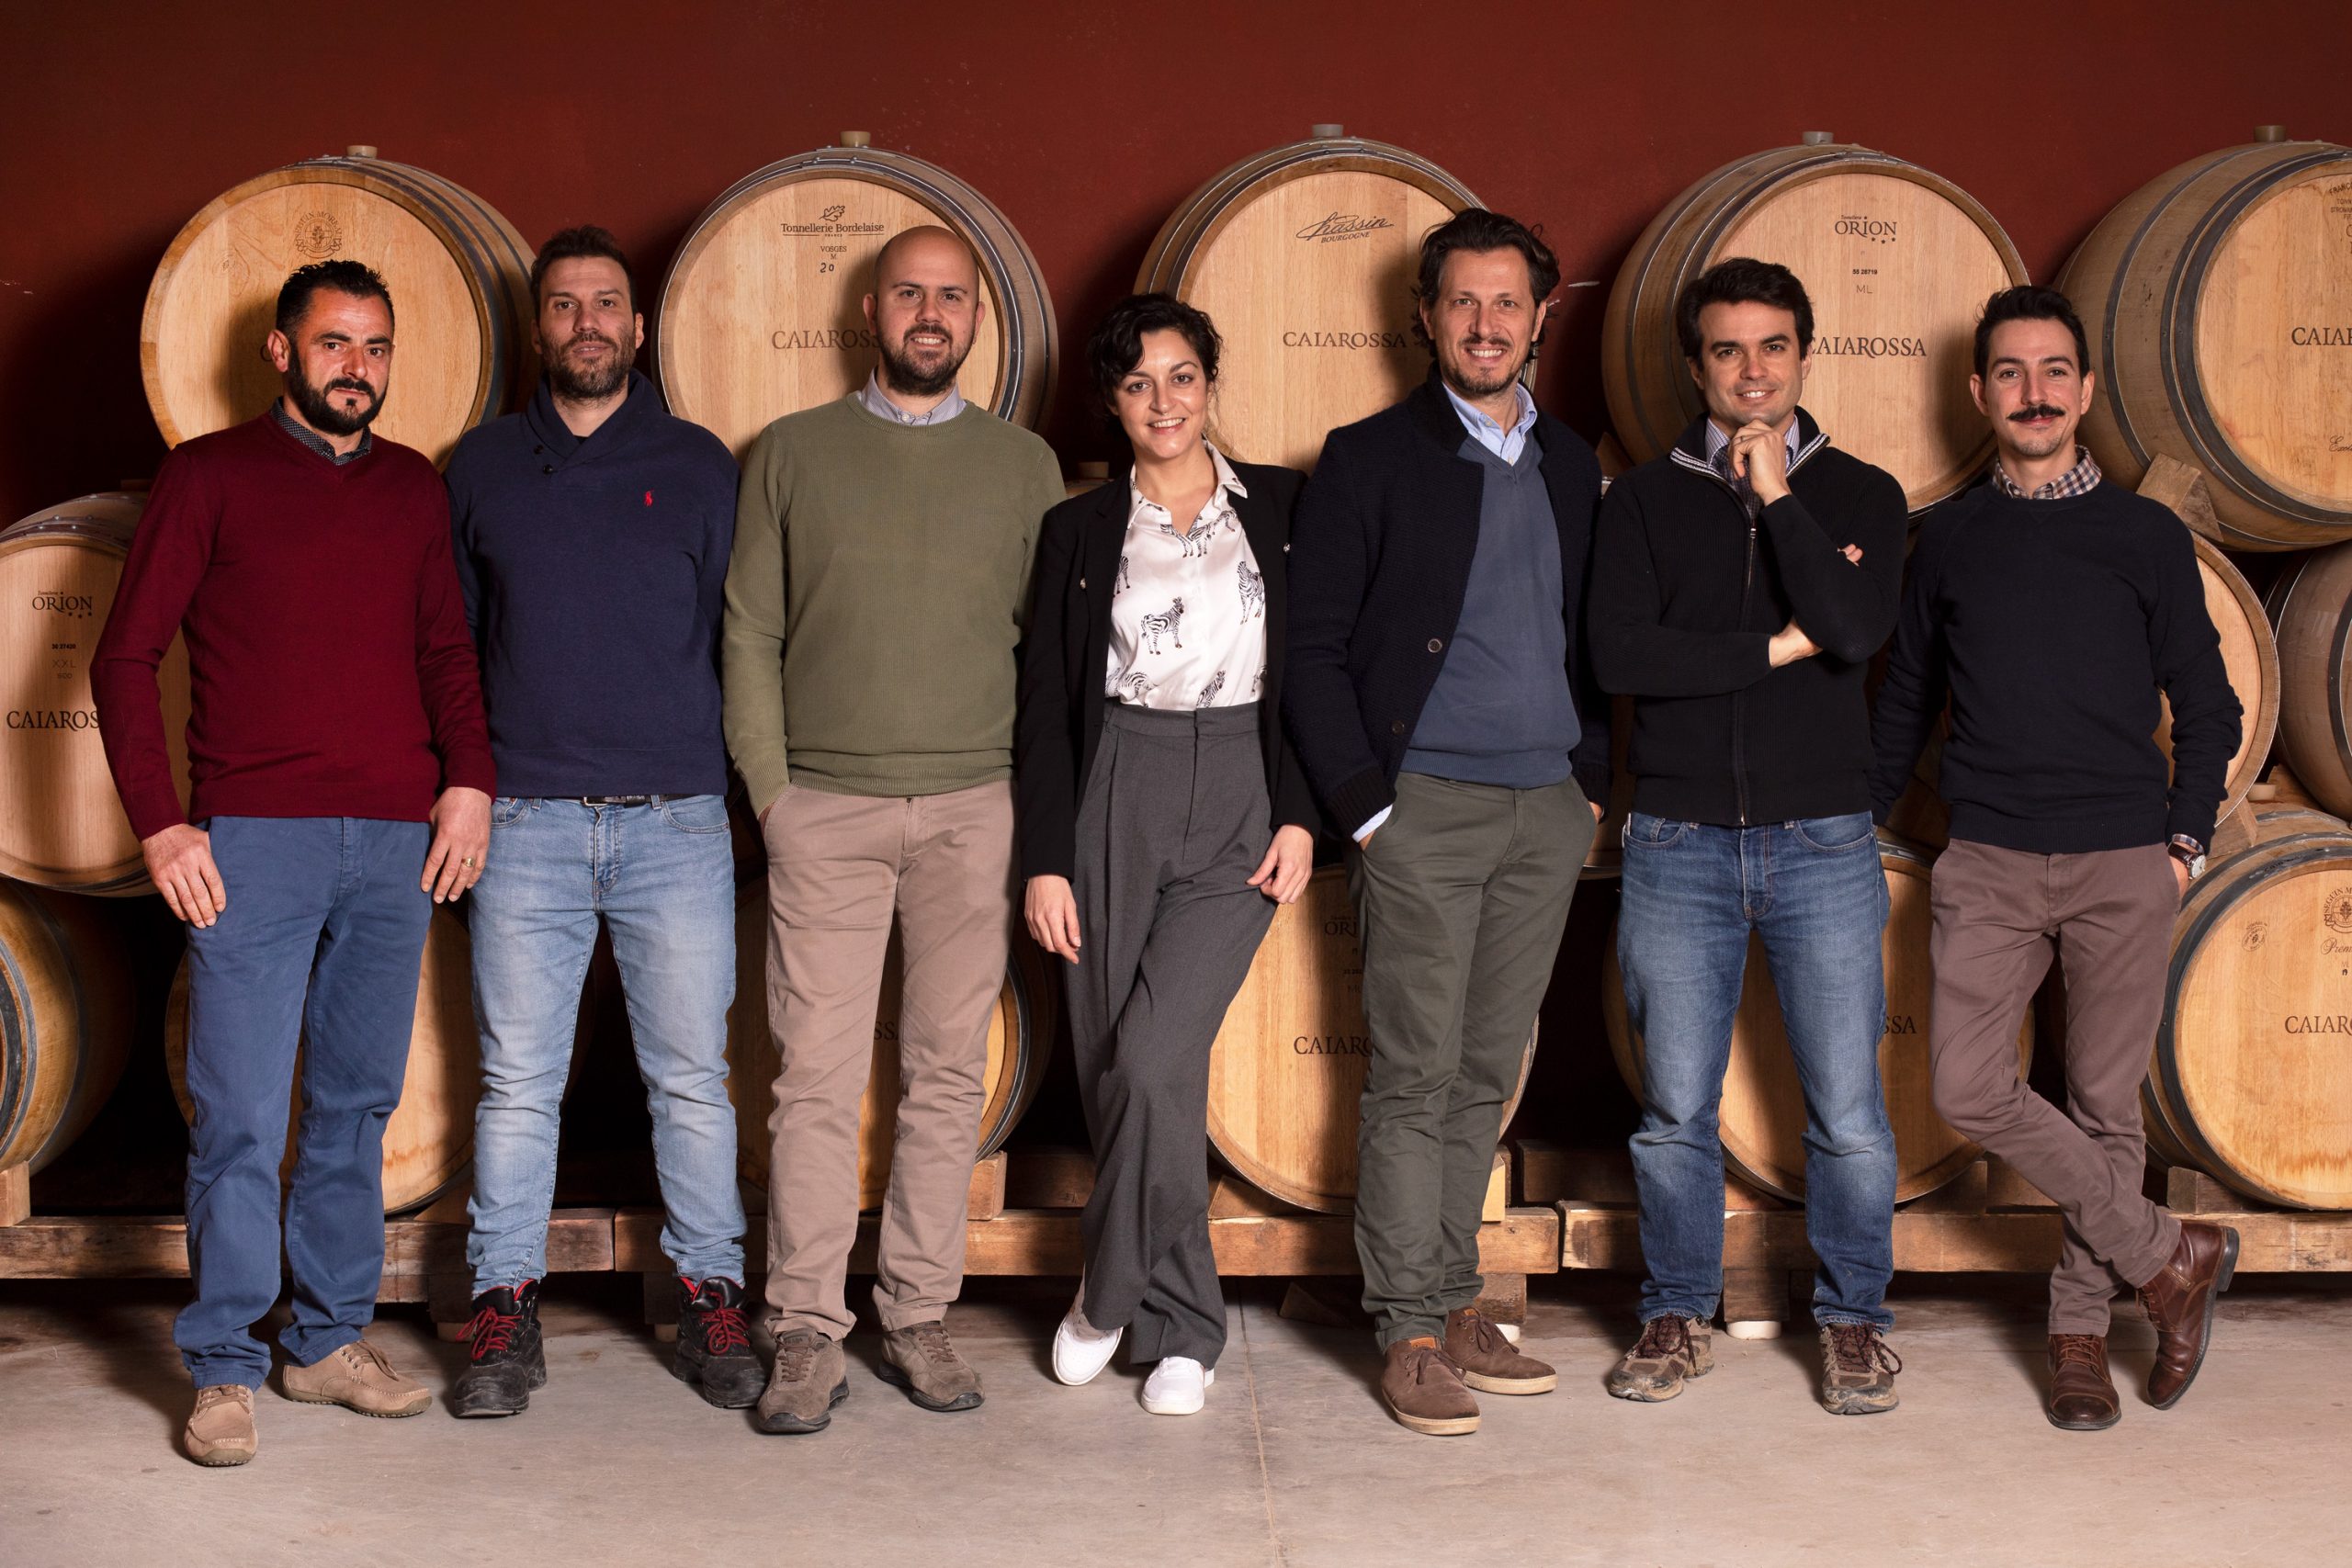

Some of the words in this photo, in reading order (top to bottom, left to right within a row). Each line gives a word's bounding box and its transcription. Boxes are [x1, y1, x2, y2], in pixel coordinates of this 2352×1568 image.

[781, 223, 833, 232] Tonnellerie
[836, 222, 885, 232] Bordelaise
[1835, 219, 1897, 238] ORION
[1320, 231, 1371, 243] BOURGOGNE
[1283, 332, 1407, 350] CAIAROSSA
[32, 595, 93, 614] ORION
[2284, 1015, 2352, 1036] CAIAR
